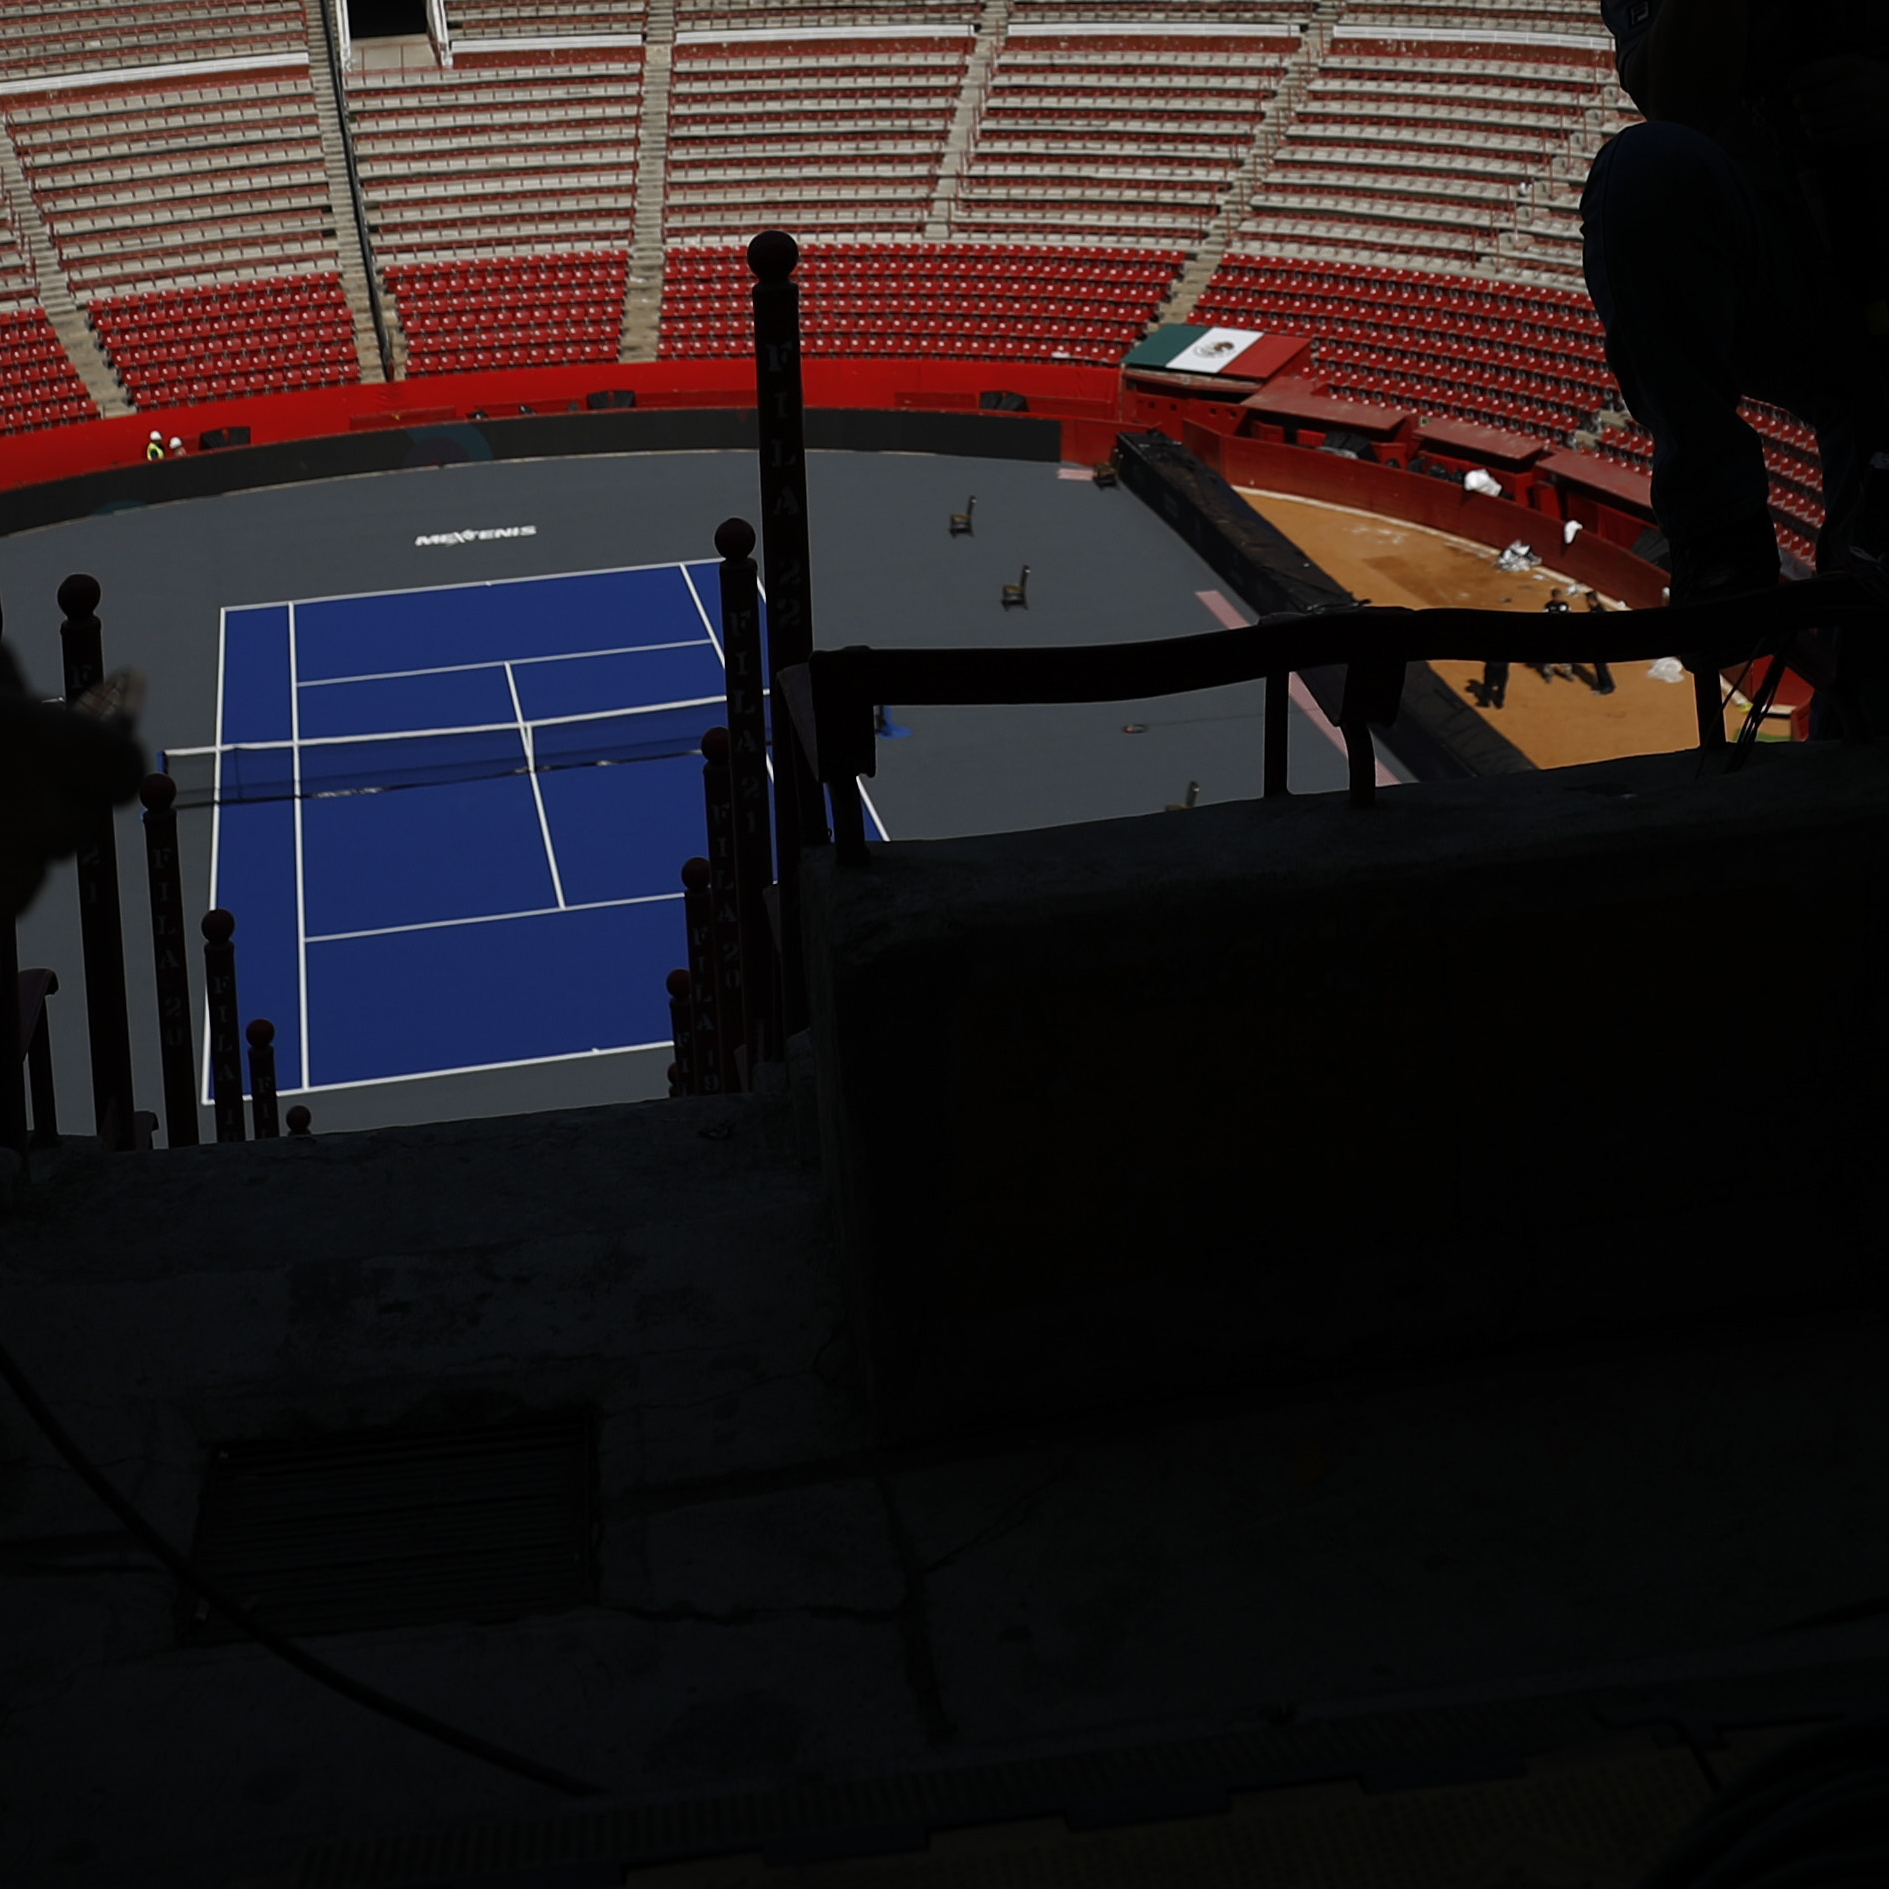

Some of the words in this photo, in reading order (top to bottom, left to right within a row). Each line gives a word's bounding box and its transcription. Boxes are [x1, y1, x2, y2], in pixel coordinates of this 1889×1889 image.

[764, 340, 801, 517] FILA
[727, 611, 759, 754] FILA
[152, 848, 180, 969] FILA
[710, 802, 738, 923] FILA
